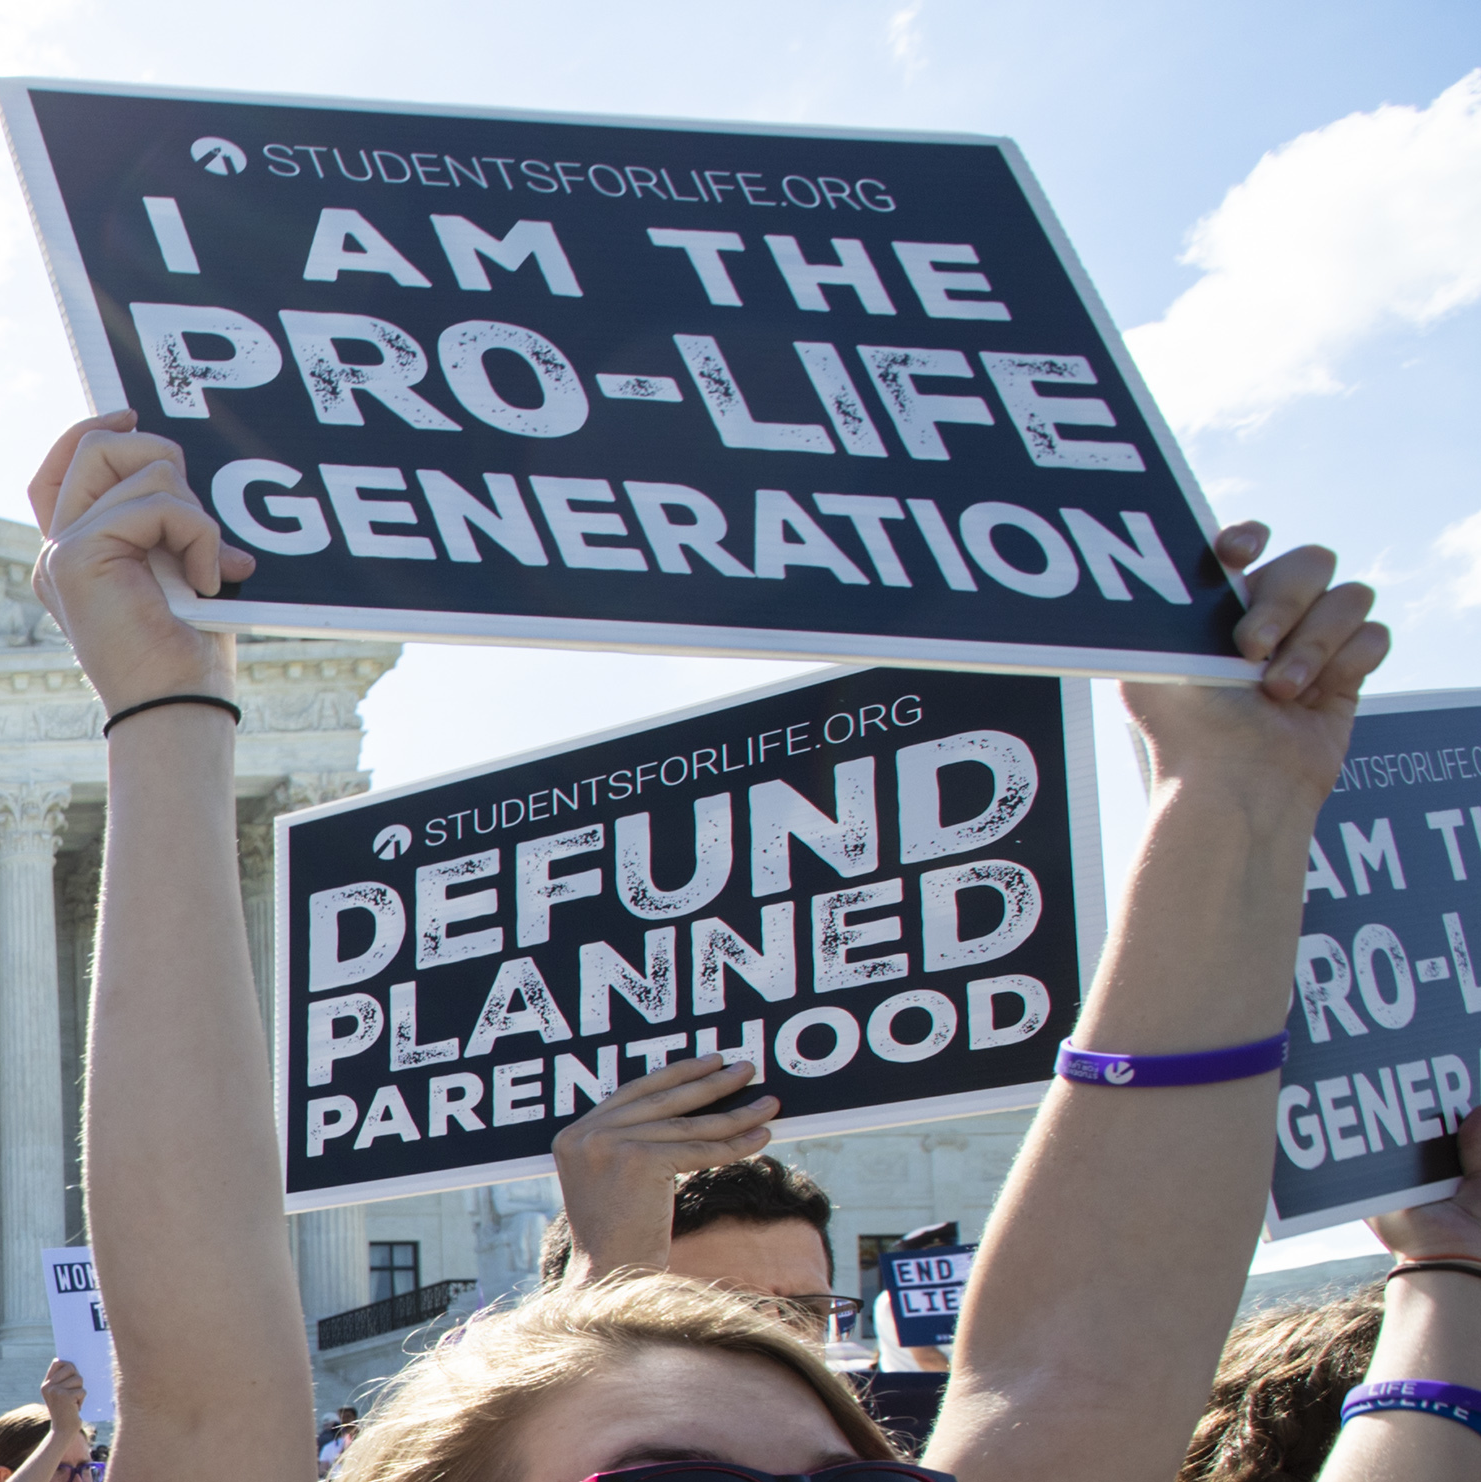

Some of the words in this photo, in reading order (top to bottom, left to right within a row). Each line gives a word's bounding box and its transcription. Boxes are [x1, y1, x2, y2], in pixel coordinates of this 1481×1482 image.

[262, 143, 897, 212] STUDENTSFORLIFE.ORG
[142, 195, 201, 275] I
[302, 207, 584, 298] AM
[646, 227, 1012, 322] THE
[129, 301, 1147, 472] PRO-LIFE
[211, 457, 1193, 605] GENERATION
[423, 693, 924, 848] STUDENTSFORLIFE.ORG
[308, 728, 1040, 993] DEFUND
[1302, 816, 1408, 904] AM
[305, 858, 1042, 1088] PLANNED
[896, 1259, 954, 1283] END
[1367, 1381, 1417, 1397] LIFE
